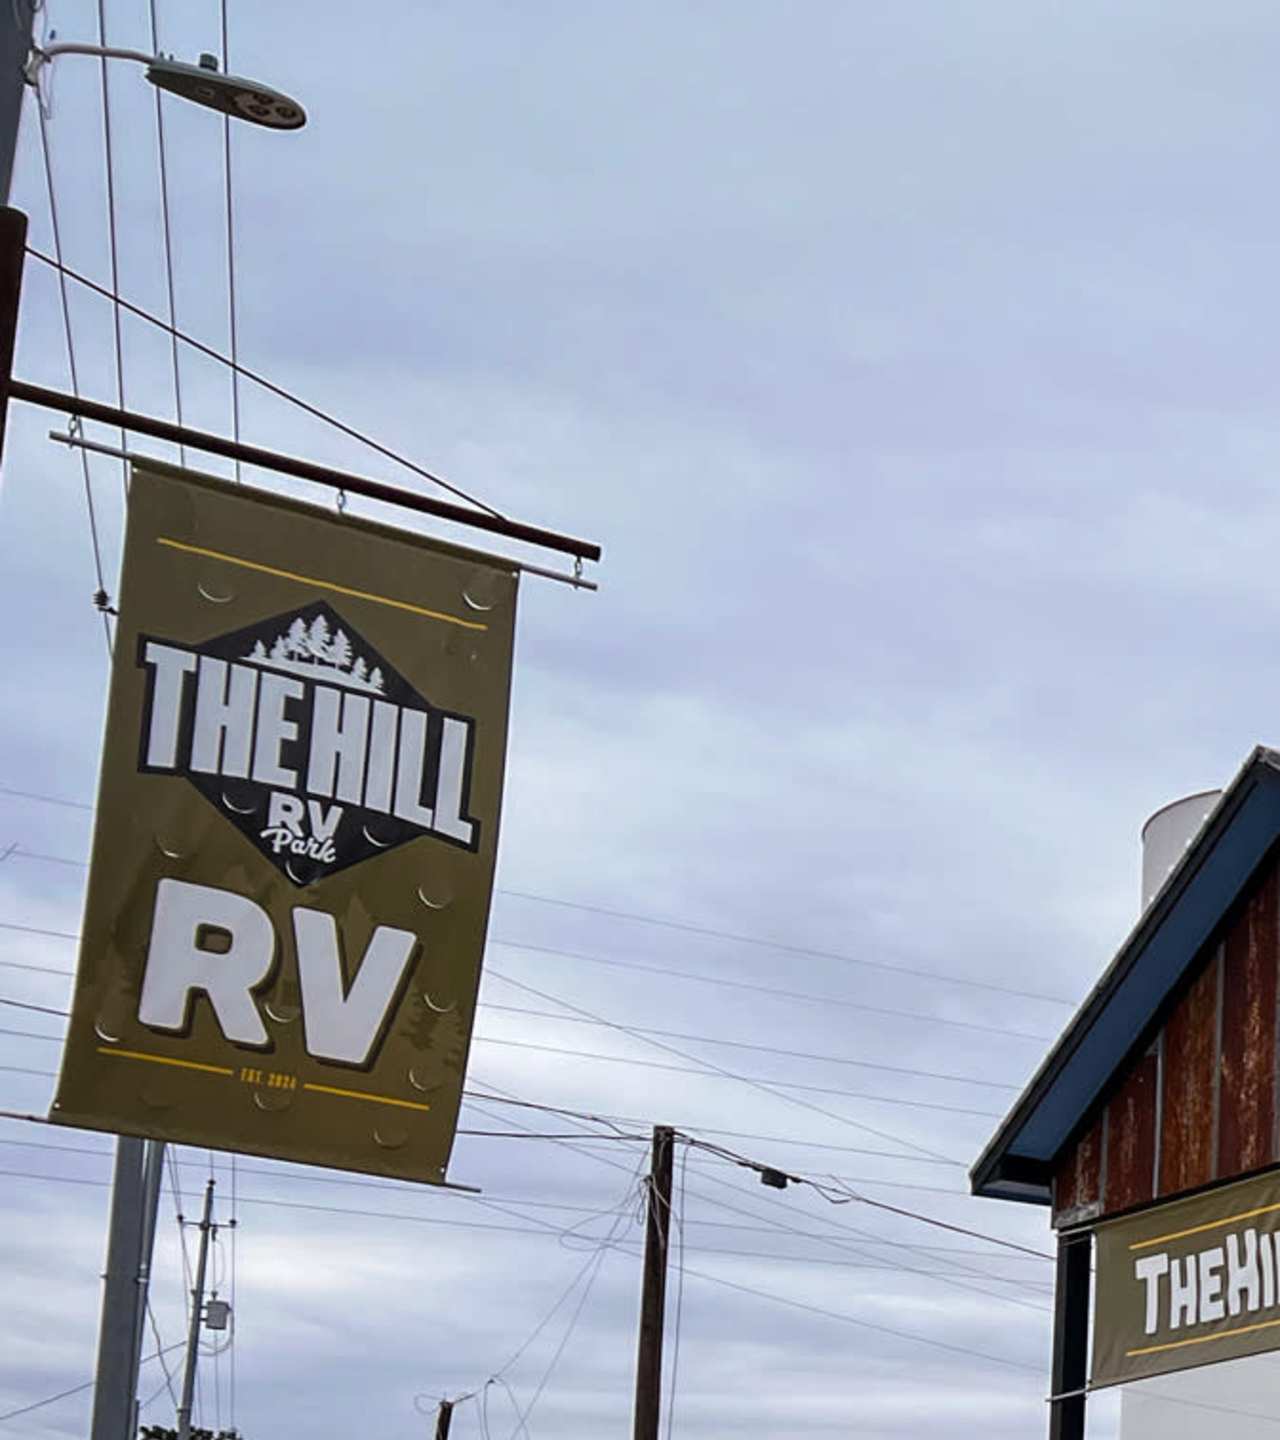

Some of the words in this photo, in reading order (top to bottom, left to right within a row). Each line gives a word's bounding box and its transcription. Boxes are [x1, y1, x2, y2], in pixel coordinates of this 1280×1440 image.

[267, 791, 343, 843] RV
[260, 828, 336, 863] Park
[138, 877, 417, 1064] RV
